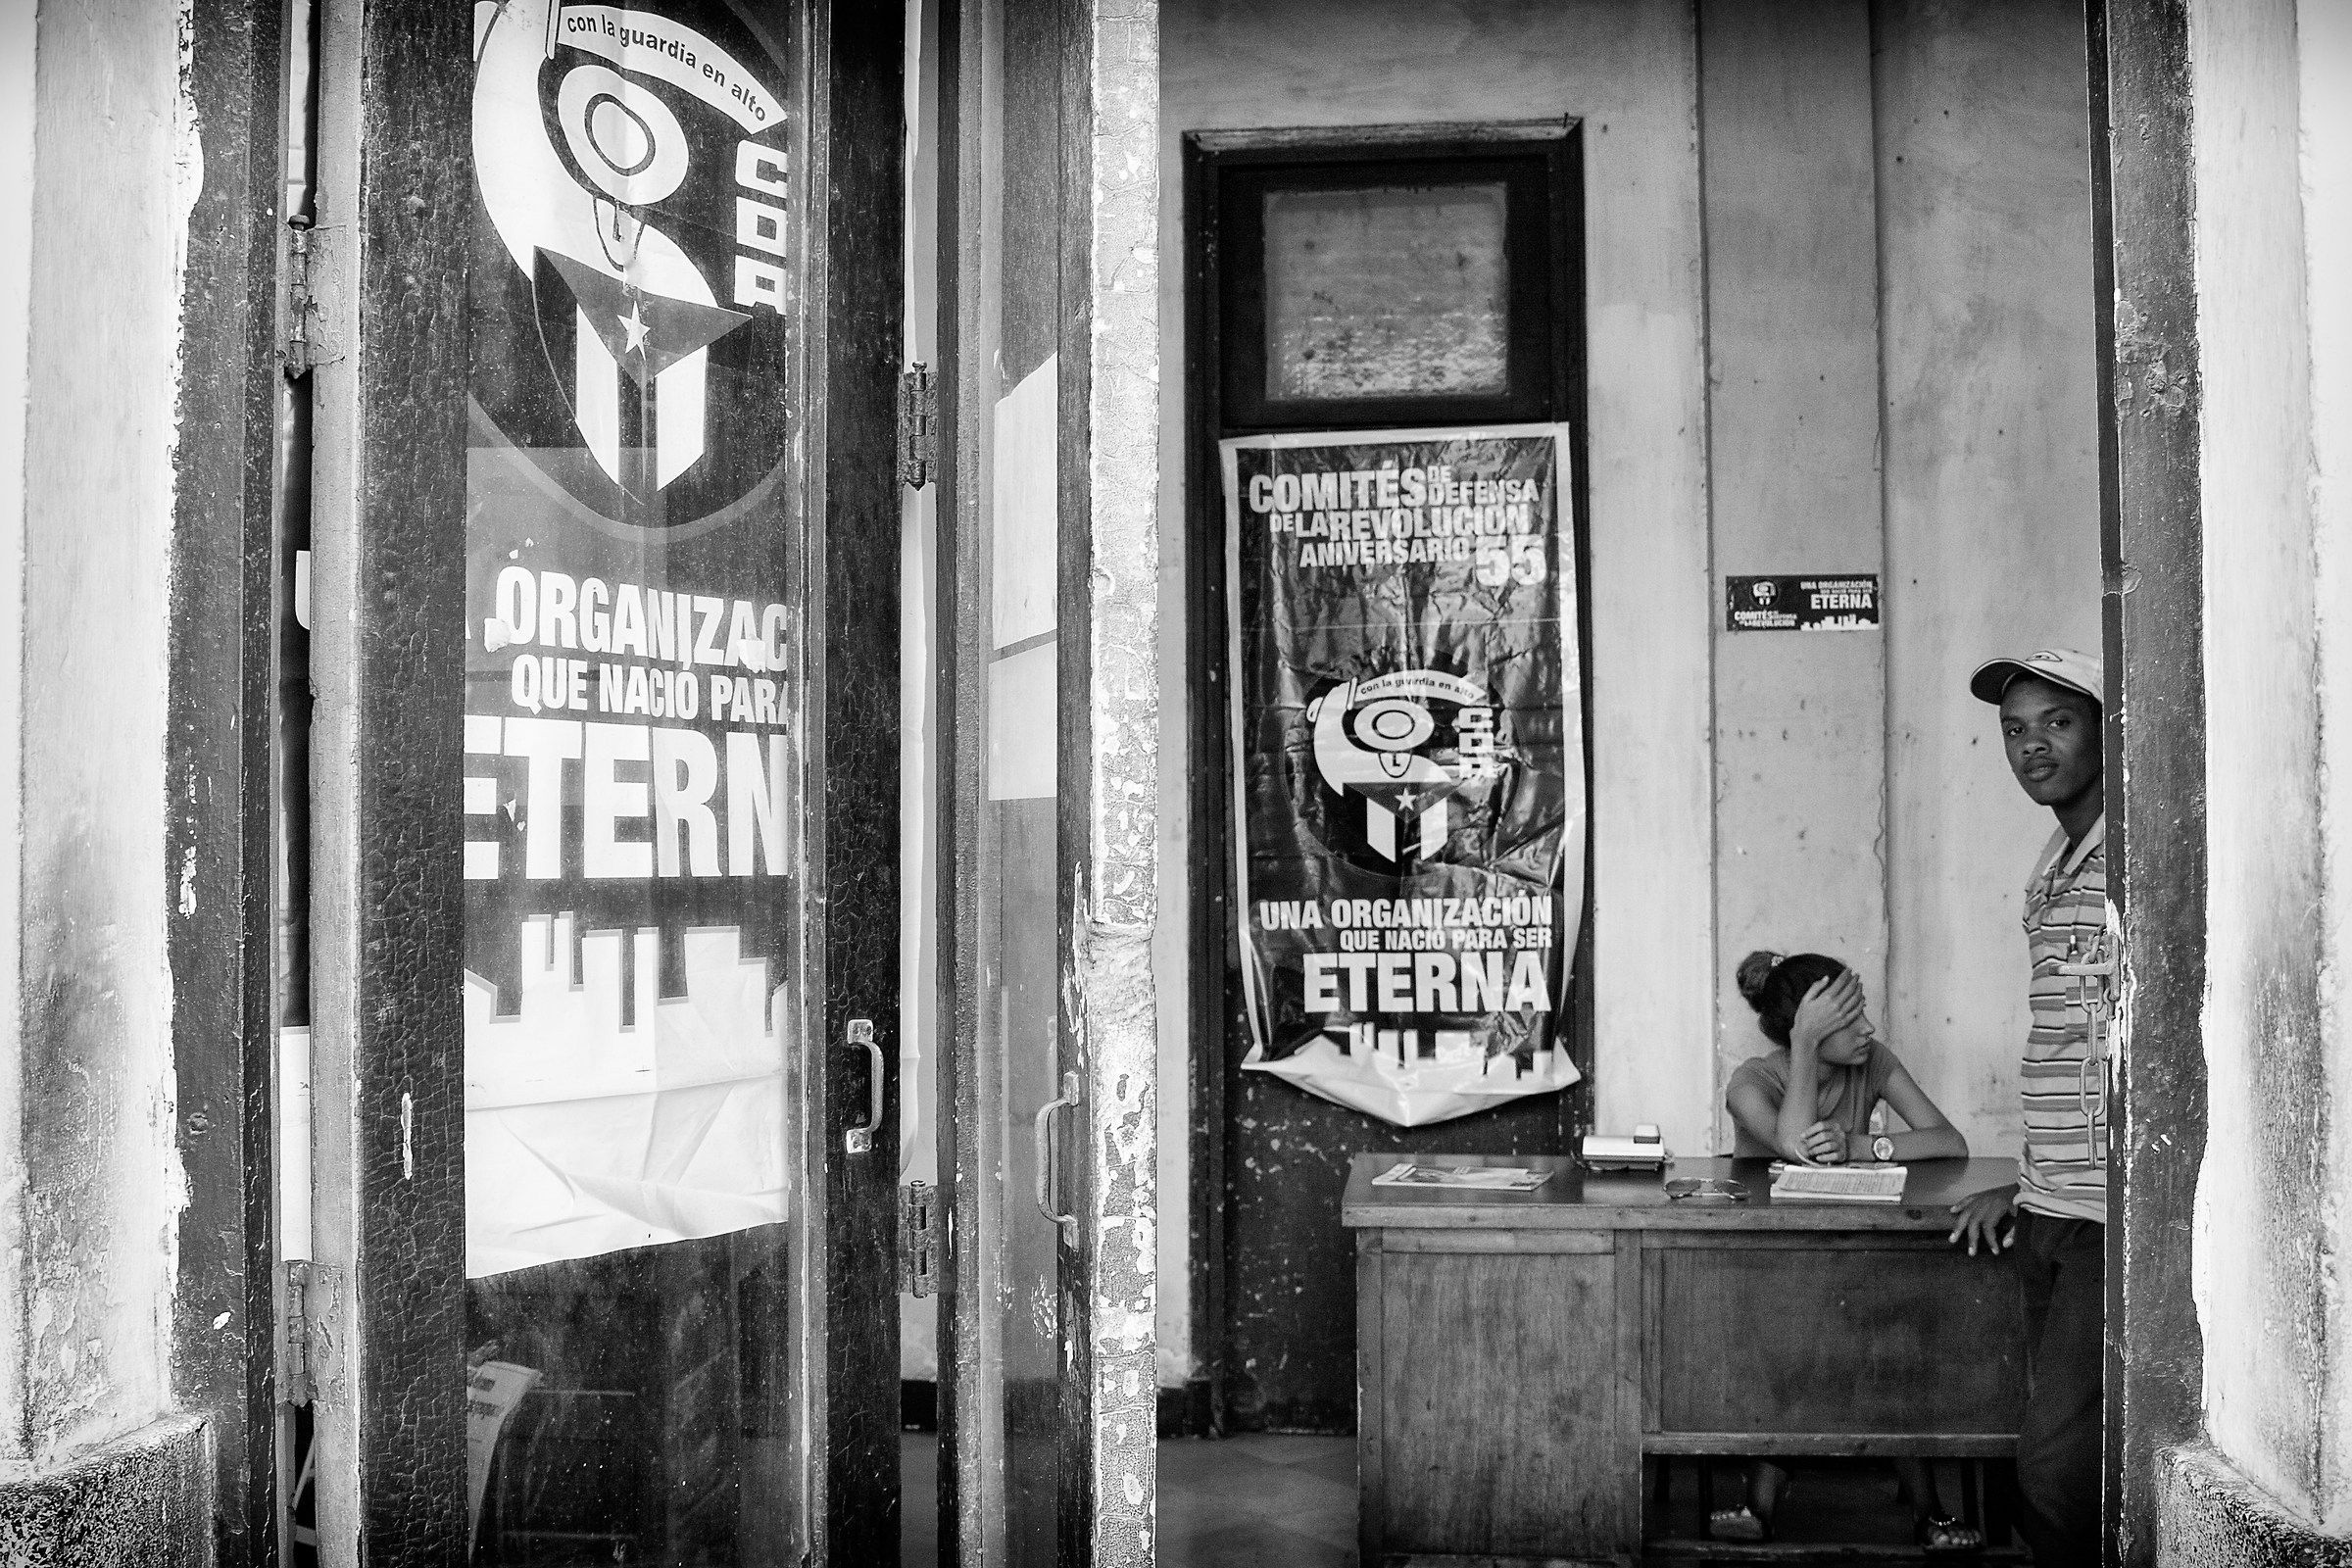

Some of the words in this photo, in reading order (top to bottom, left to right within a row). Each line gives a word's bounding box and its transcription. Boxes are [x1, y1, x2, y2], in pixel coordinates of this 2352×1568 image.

[566, 14, 597, 33] con
[601, 14, 615, 37] la
[619, 24, 697, 69] guardia
[702, 61, 726, 88] en
[730, 82, 766, 123] alto
[1249, 459, 1427, 514] COMITÉS
[1427, 466, 1451, 483] DE
[1428, 478, 1540, 506] DEFENSA
[1269, 513, 1295, 533] DE
[1299, 536, 1470, 567] ANIVERSARIO
[1475, 534, 1547, 587] 55
[1810, 593, 1873, 610] ETERNA
[511, 654, 588, 715] QUE
[599, 662, 699, 720] NACIÓ
[1360, 683, 1379, 695] con
[1454, 686, 1474, 699] alto
[1260, 900, 1323, 931] UNA
[1331, 889, 1552, 929] ORGANIZACIÓN
[1340, 930, 1380, 953] QUE
[1451, 929, 1508, 951] PARA
[1512, 927, 1552, 950] SER
[1302, 950, 1551, 1012] ETERNA
